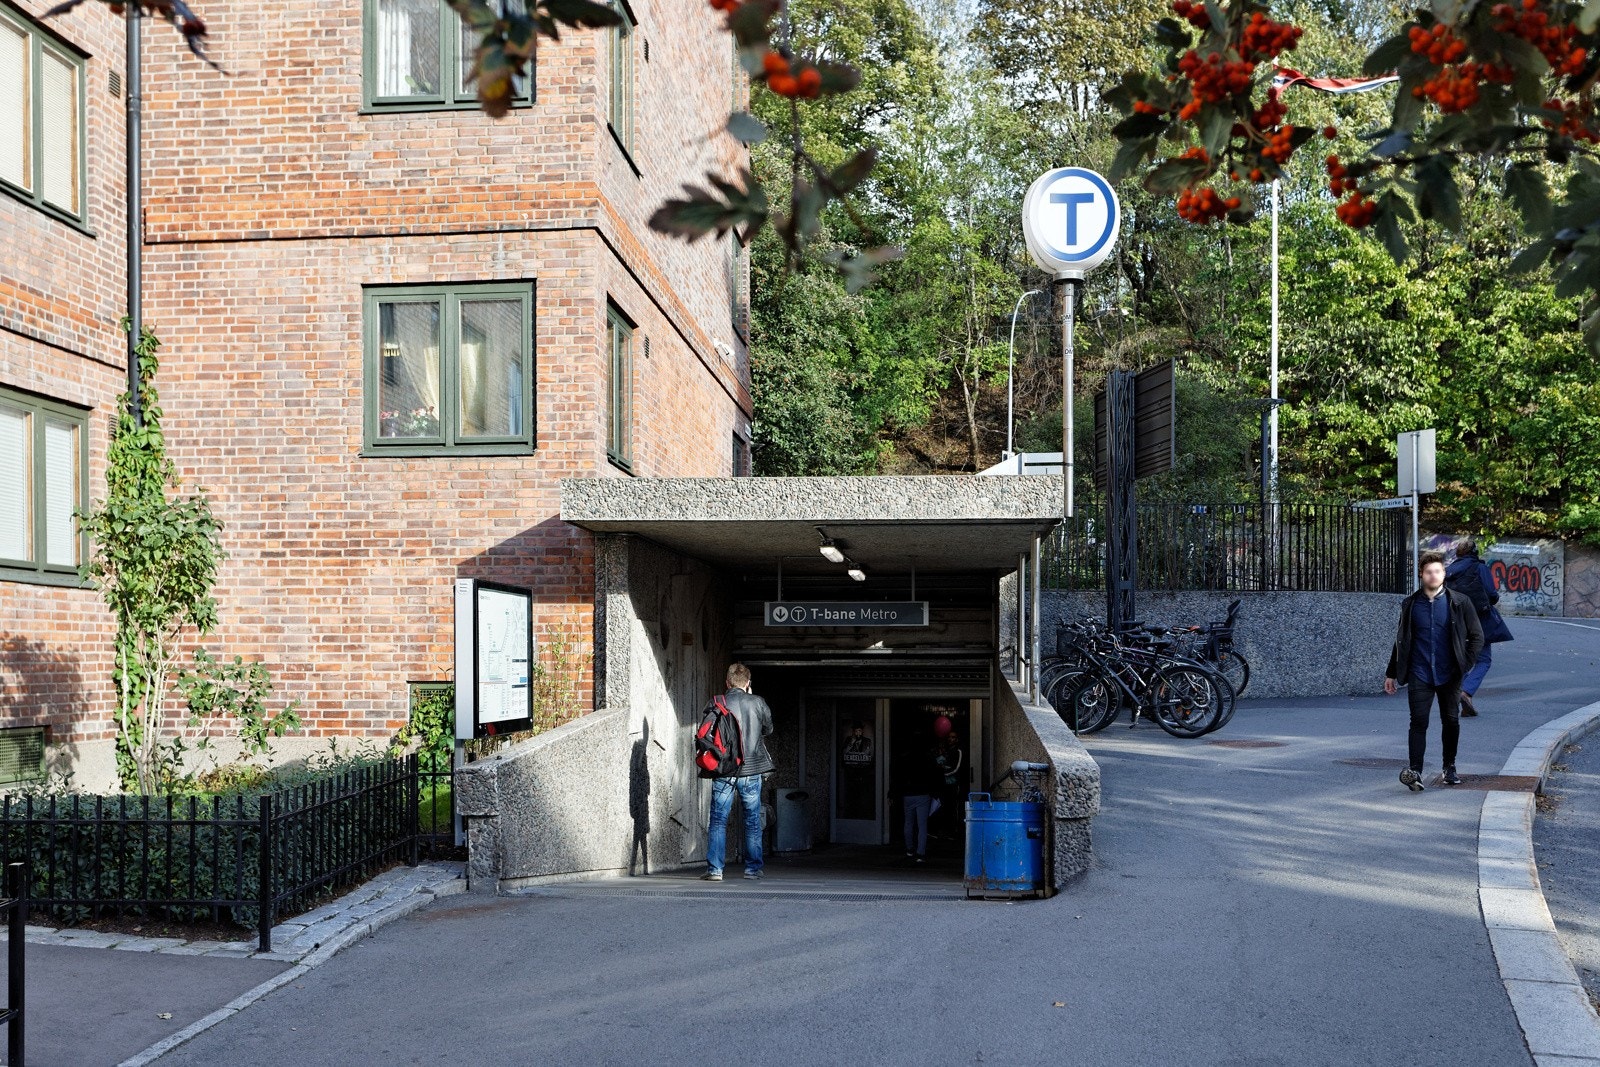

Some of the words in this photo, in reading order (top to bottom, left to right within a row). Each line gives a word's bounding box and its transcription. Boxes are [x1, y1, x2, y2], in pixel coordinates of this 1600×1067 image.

[1050, 193, 1094, 246] T
[811, 608, 856, 620] T-bane
[860, 608, 897, 620] Metro
